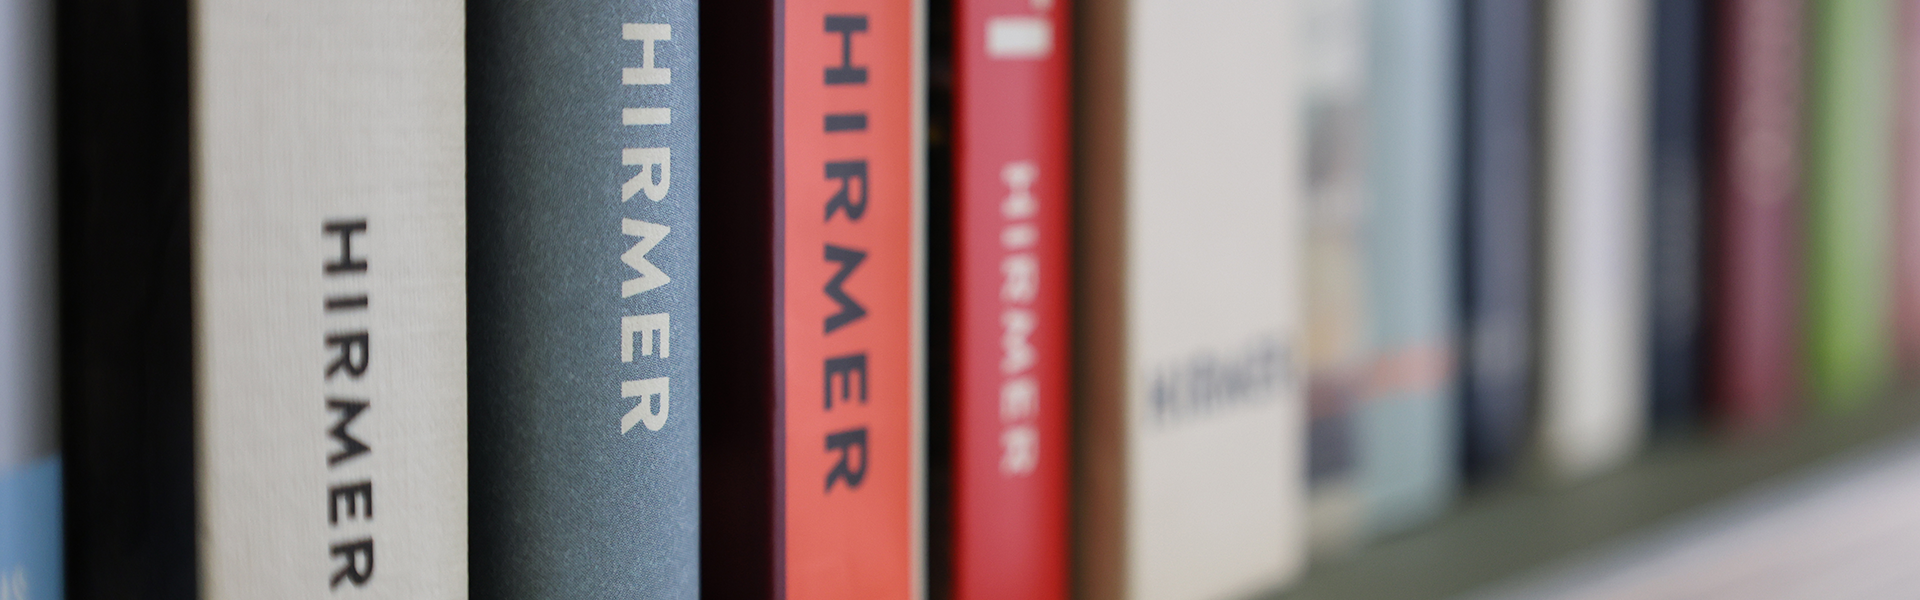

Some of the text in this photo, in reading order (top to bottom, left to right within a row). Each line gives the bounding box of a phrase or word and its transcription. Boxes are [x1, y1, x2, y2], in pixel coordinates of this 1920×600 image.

[323, 219, 374, 591] HIRMER
[621, 22, 671, 435] HIRMER
[823, 14, 868, 493] HIRMER
[1000, 158, 1040, 476] HIRMER
